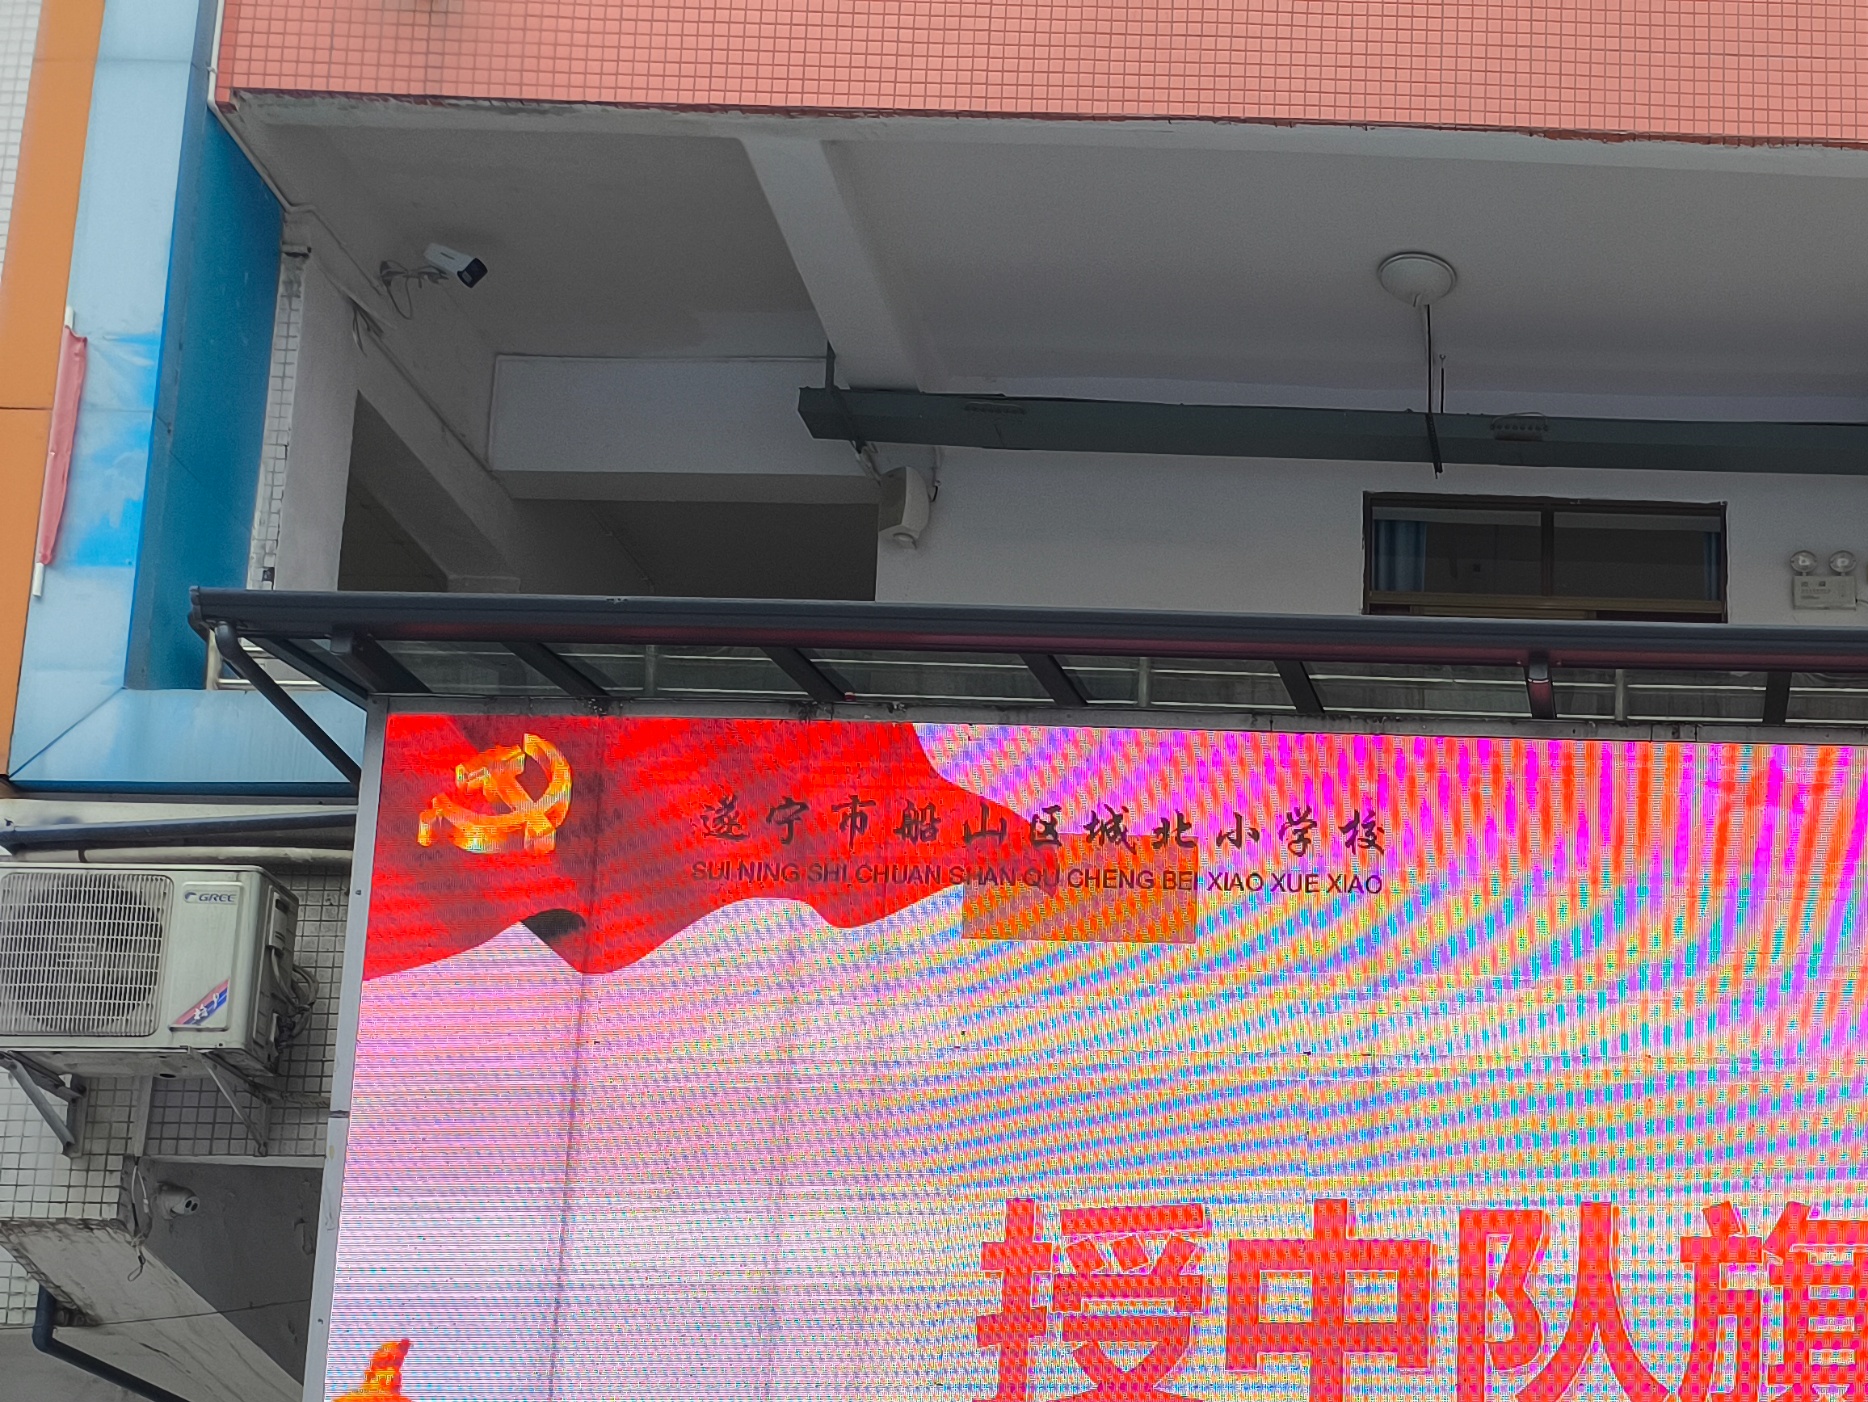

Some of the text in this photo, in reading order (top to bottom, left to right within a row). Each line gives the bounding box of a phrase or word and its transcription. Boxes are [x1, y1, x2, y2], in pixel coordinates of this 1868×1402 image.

[700, 793, 1385, 857] 遂宁市船山区城北小学校
[691, 860, 1383, 896] SUI NING SHI CHUAN SHAN QU CHENG BEI XIAO XUE XIAO
[199, 893, 237, 903] GREE
